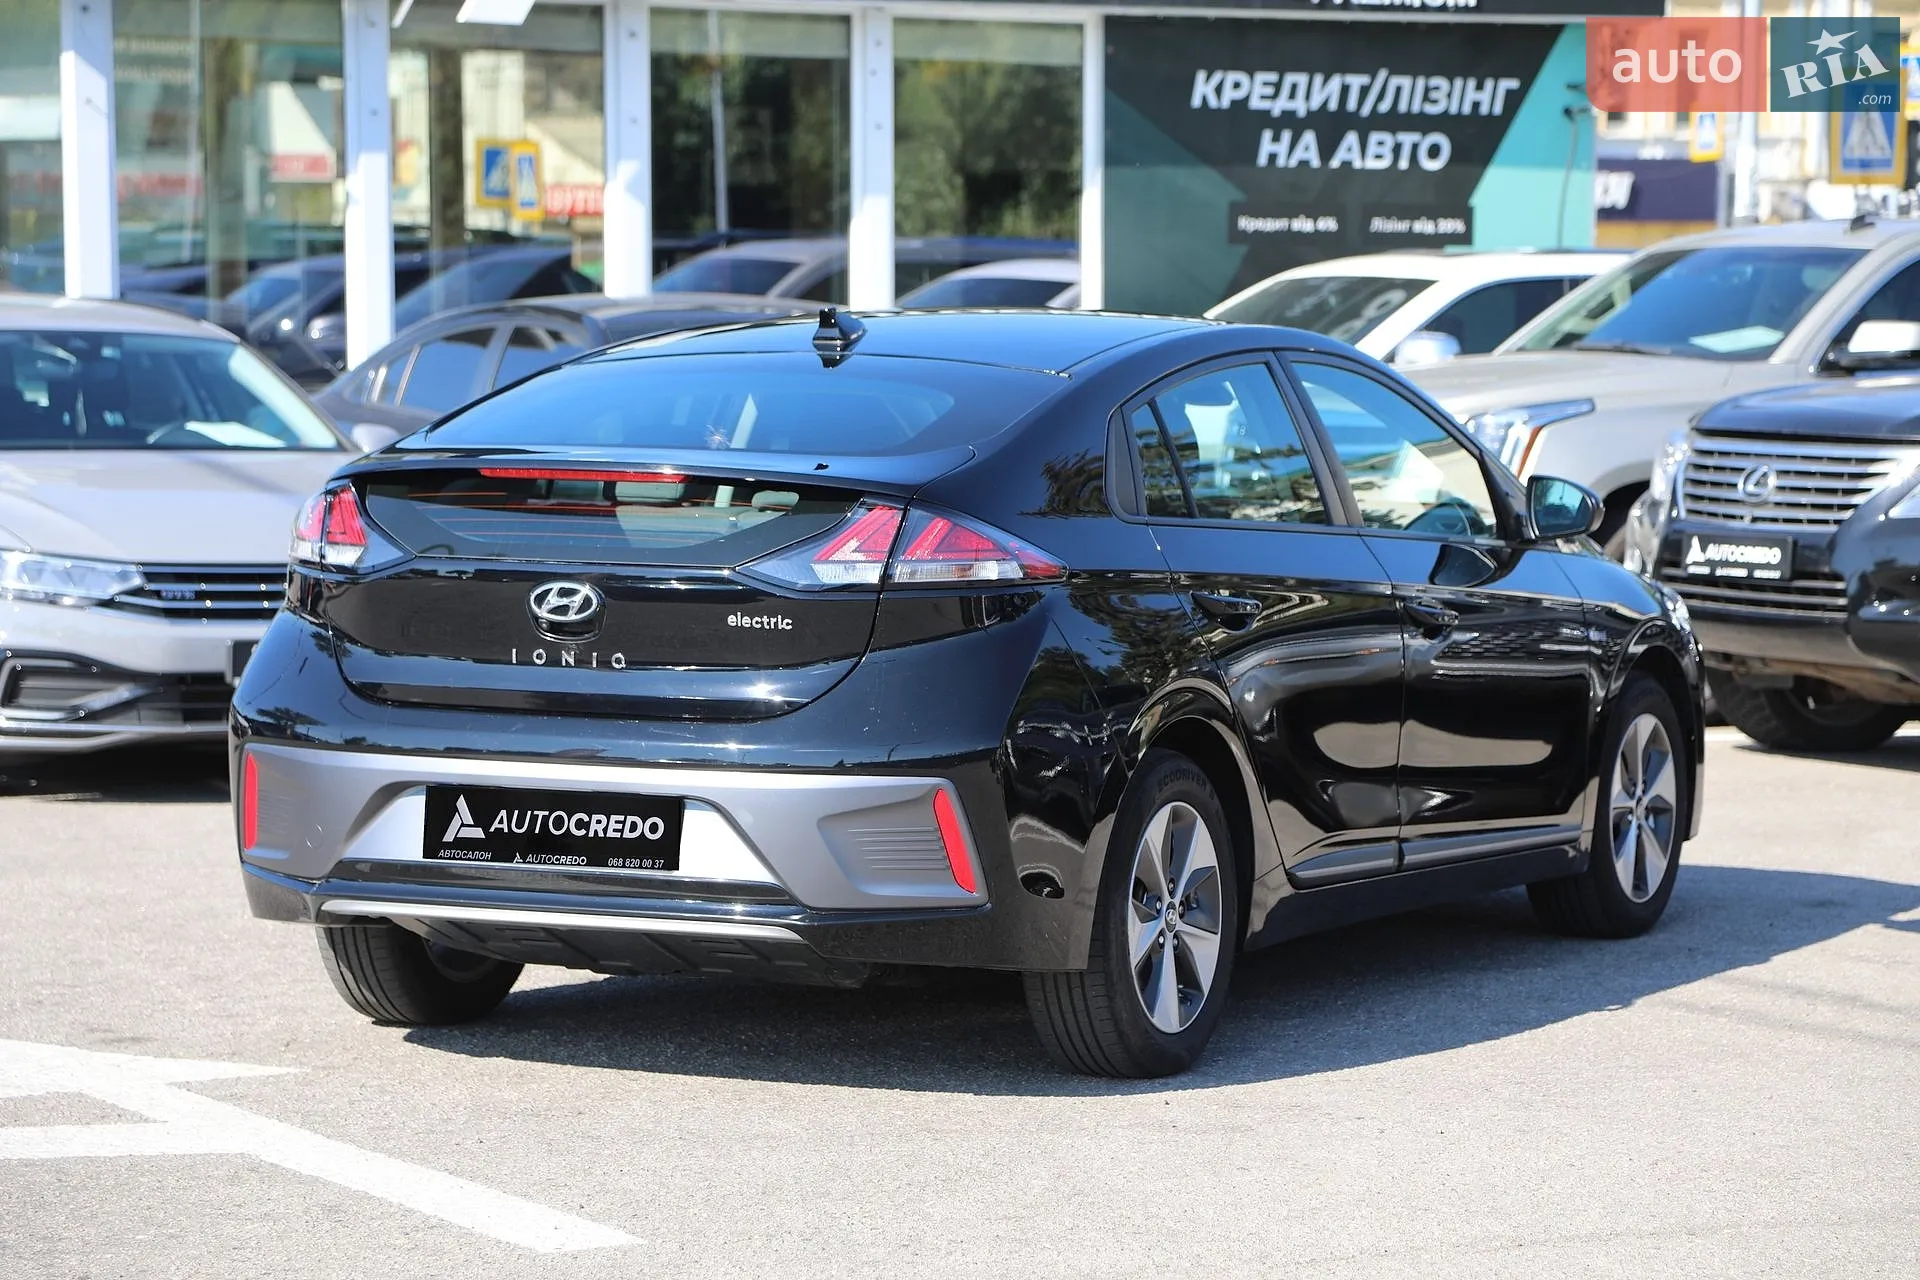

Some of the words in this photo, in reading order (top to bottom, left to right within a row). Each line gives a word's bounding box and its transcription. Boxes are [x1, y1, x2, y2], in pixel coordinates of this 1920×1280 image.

[1190, 68, 1521, 118] КРЕДИТ/ЛІЗІНГ
[1256, 128, 1321, 169] НА
[1328, 129, 1452, 172] АВТО
[727, 611, 793, 630] electric
[511, 648, 627, 669] IONIQ
[489, 809, 665, 841] AUTOCREDO
[437, 849, 492, 861] АВТОСАЛОН
[525, 853, 587, 866] AUTOCREDO
[607, 857, 623, 868] 068
[625, 858, 640, 868] 820
[641, 859, 653, 869] 00
[654, 859, 665, 869] 37
